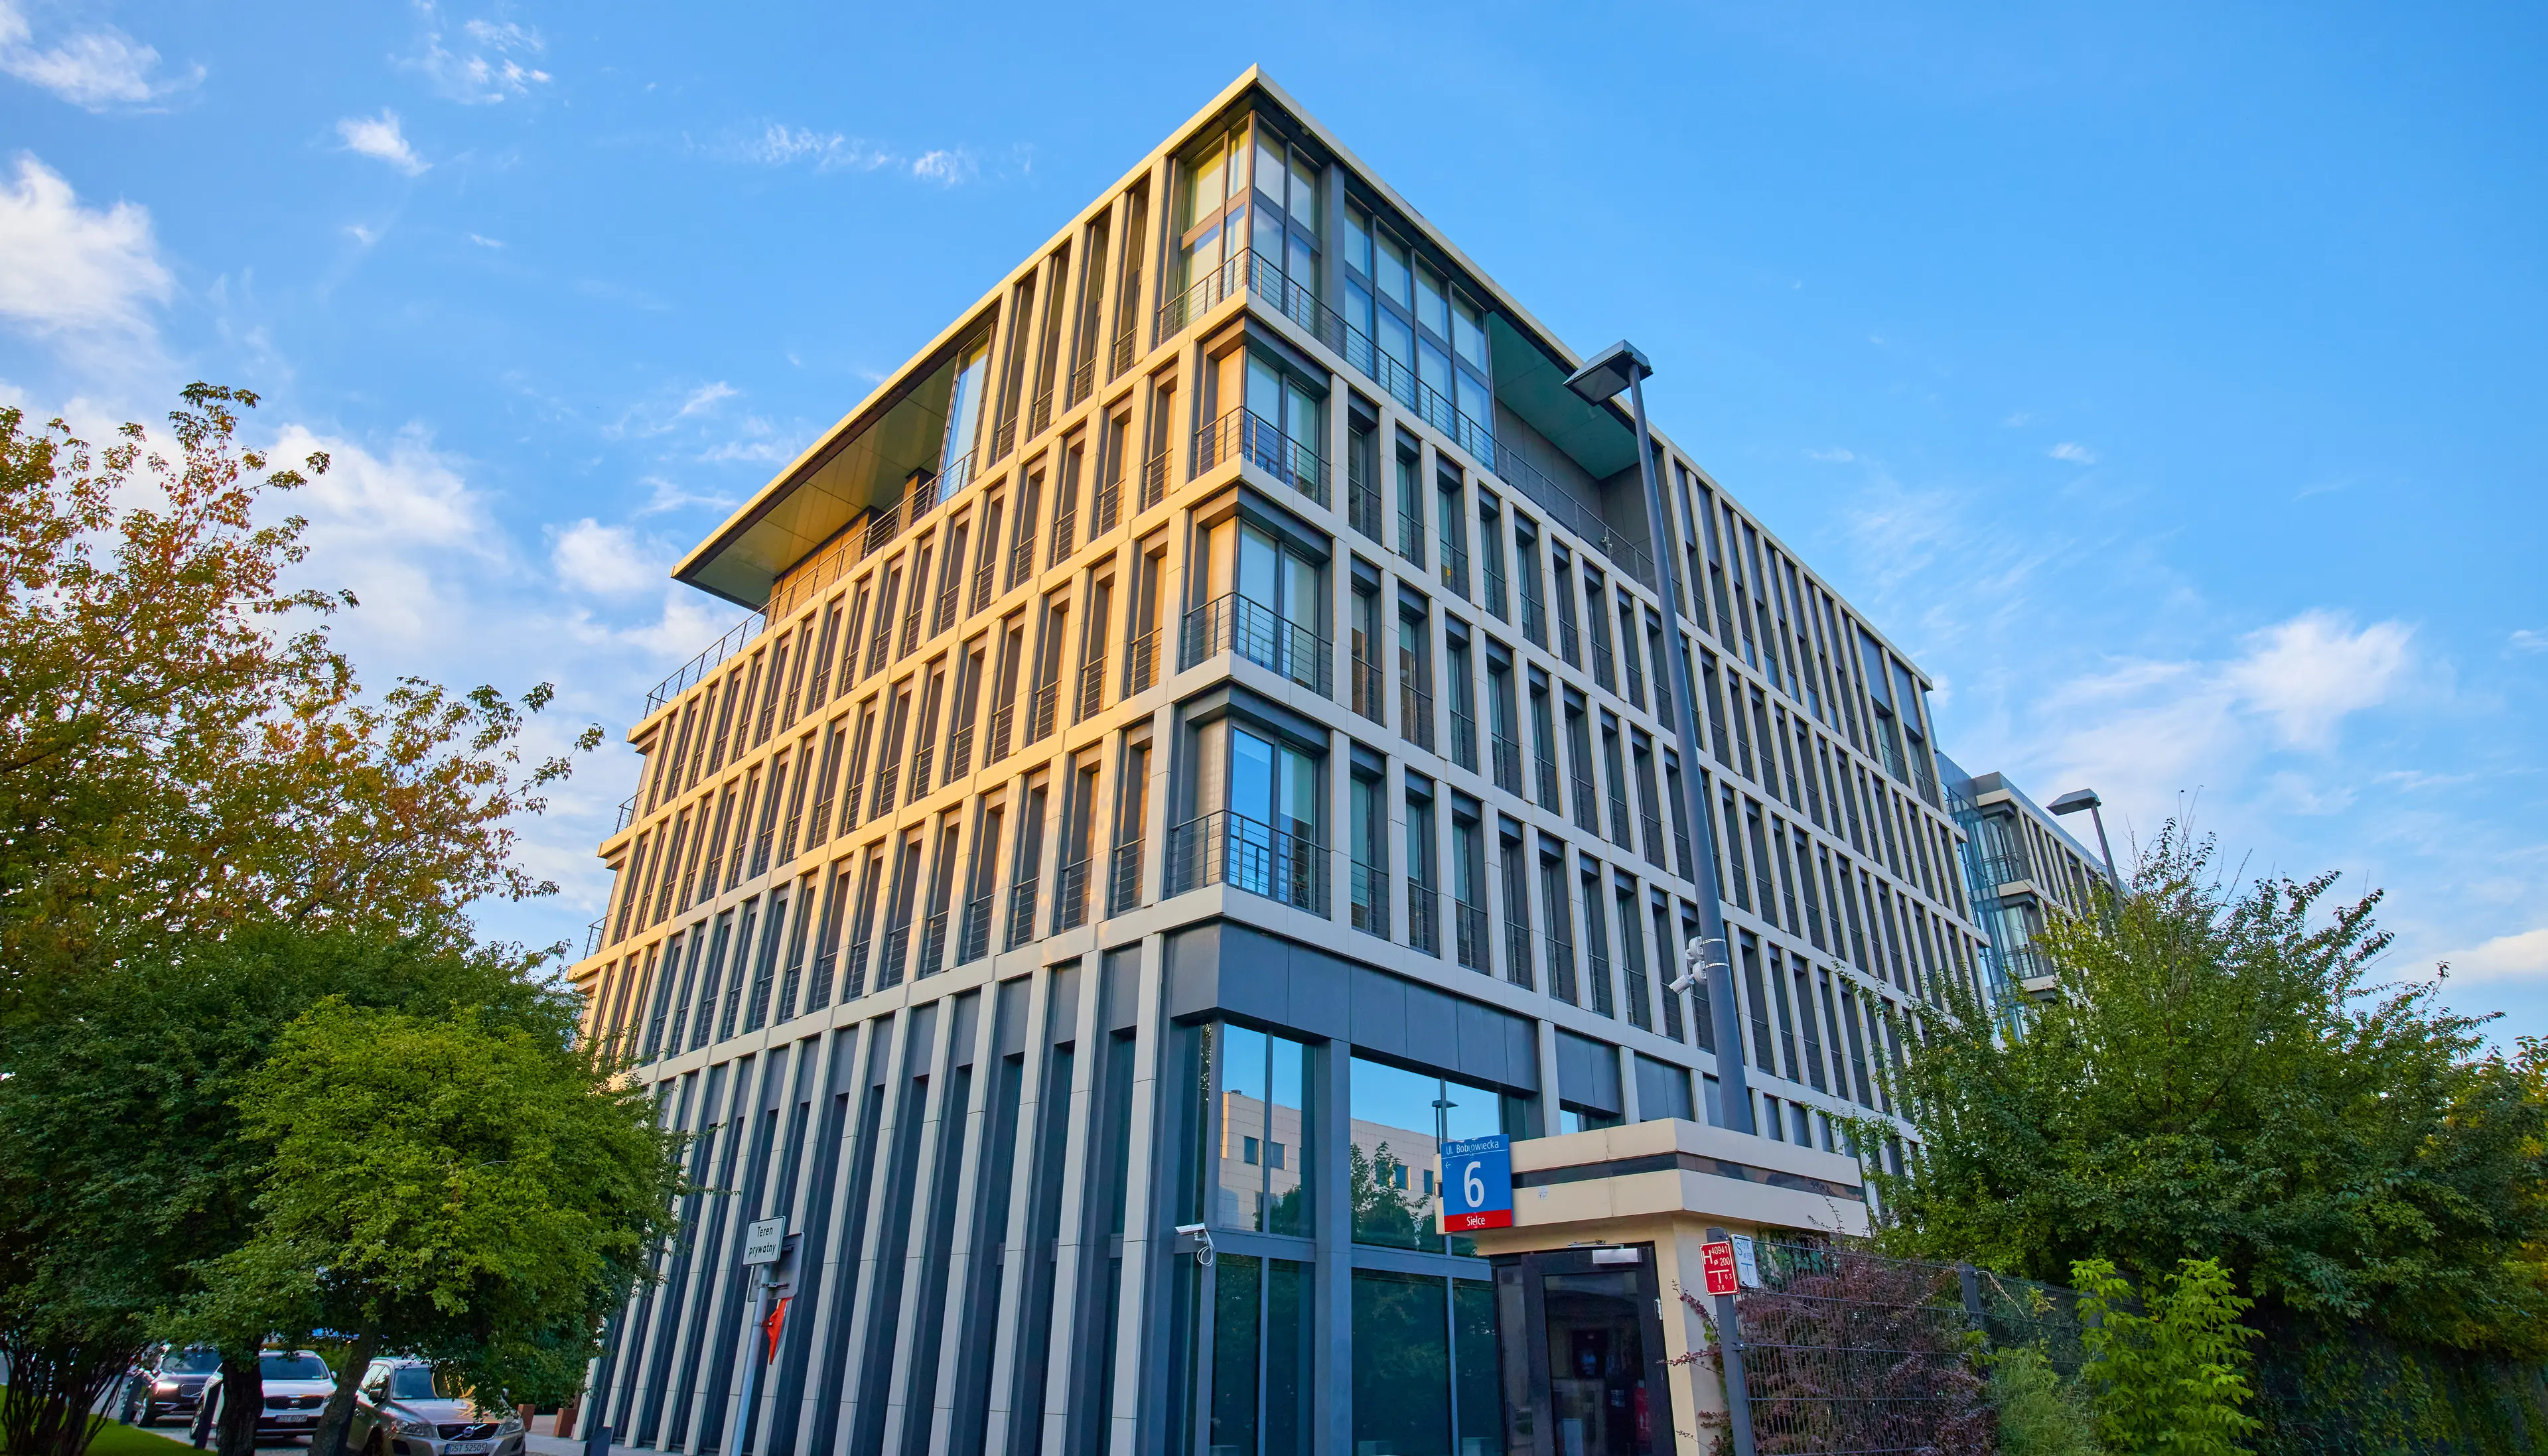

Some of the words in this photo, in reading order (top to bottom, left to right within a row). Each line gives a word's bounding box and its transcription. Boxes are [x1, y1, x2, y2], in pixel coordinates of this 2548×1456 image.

[1456, 1140, 1499, 1154] Bobrowiecka
[1464, 1161, 1485, 1208] 6
[1466, 1215, 1486, 1226] Sielce
[757, 1226, 773, 1237] Teren
[748, 1242, 776, 1258] prywatny
[1702, 1250, 1713, 1264] H
[1711, 1246, 1729, 1255] 40941
[1719, 1257, 1731, 1266] 200
